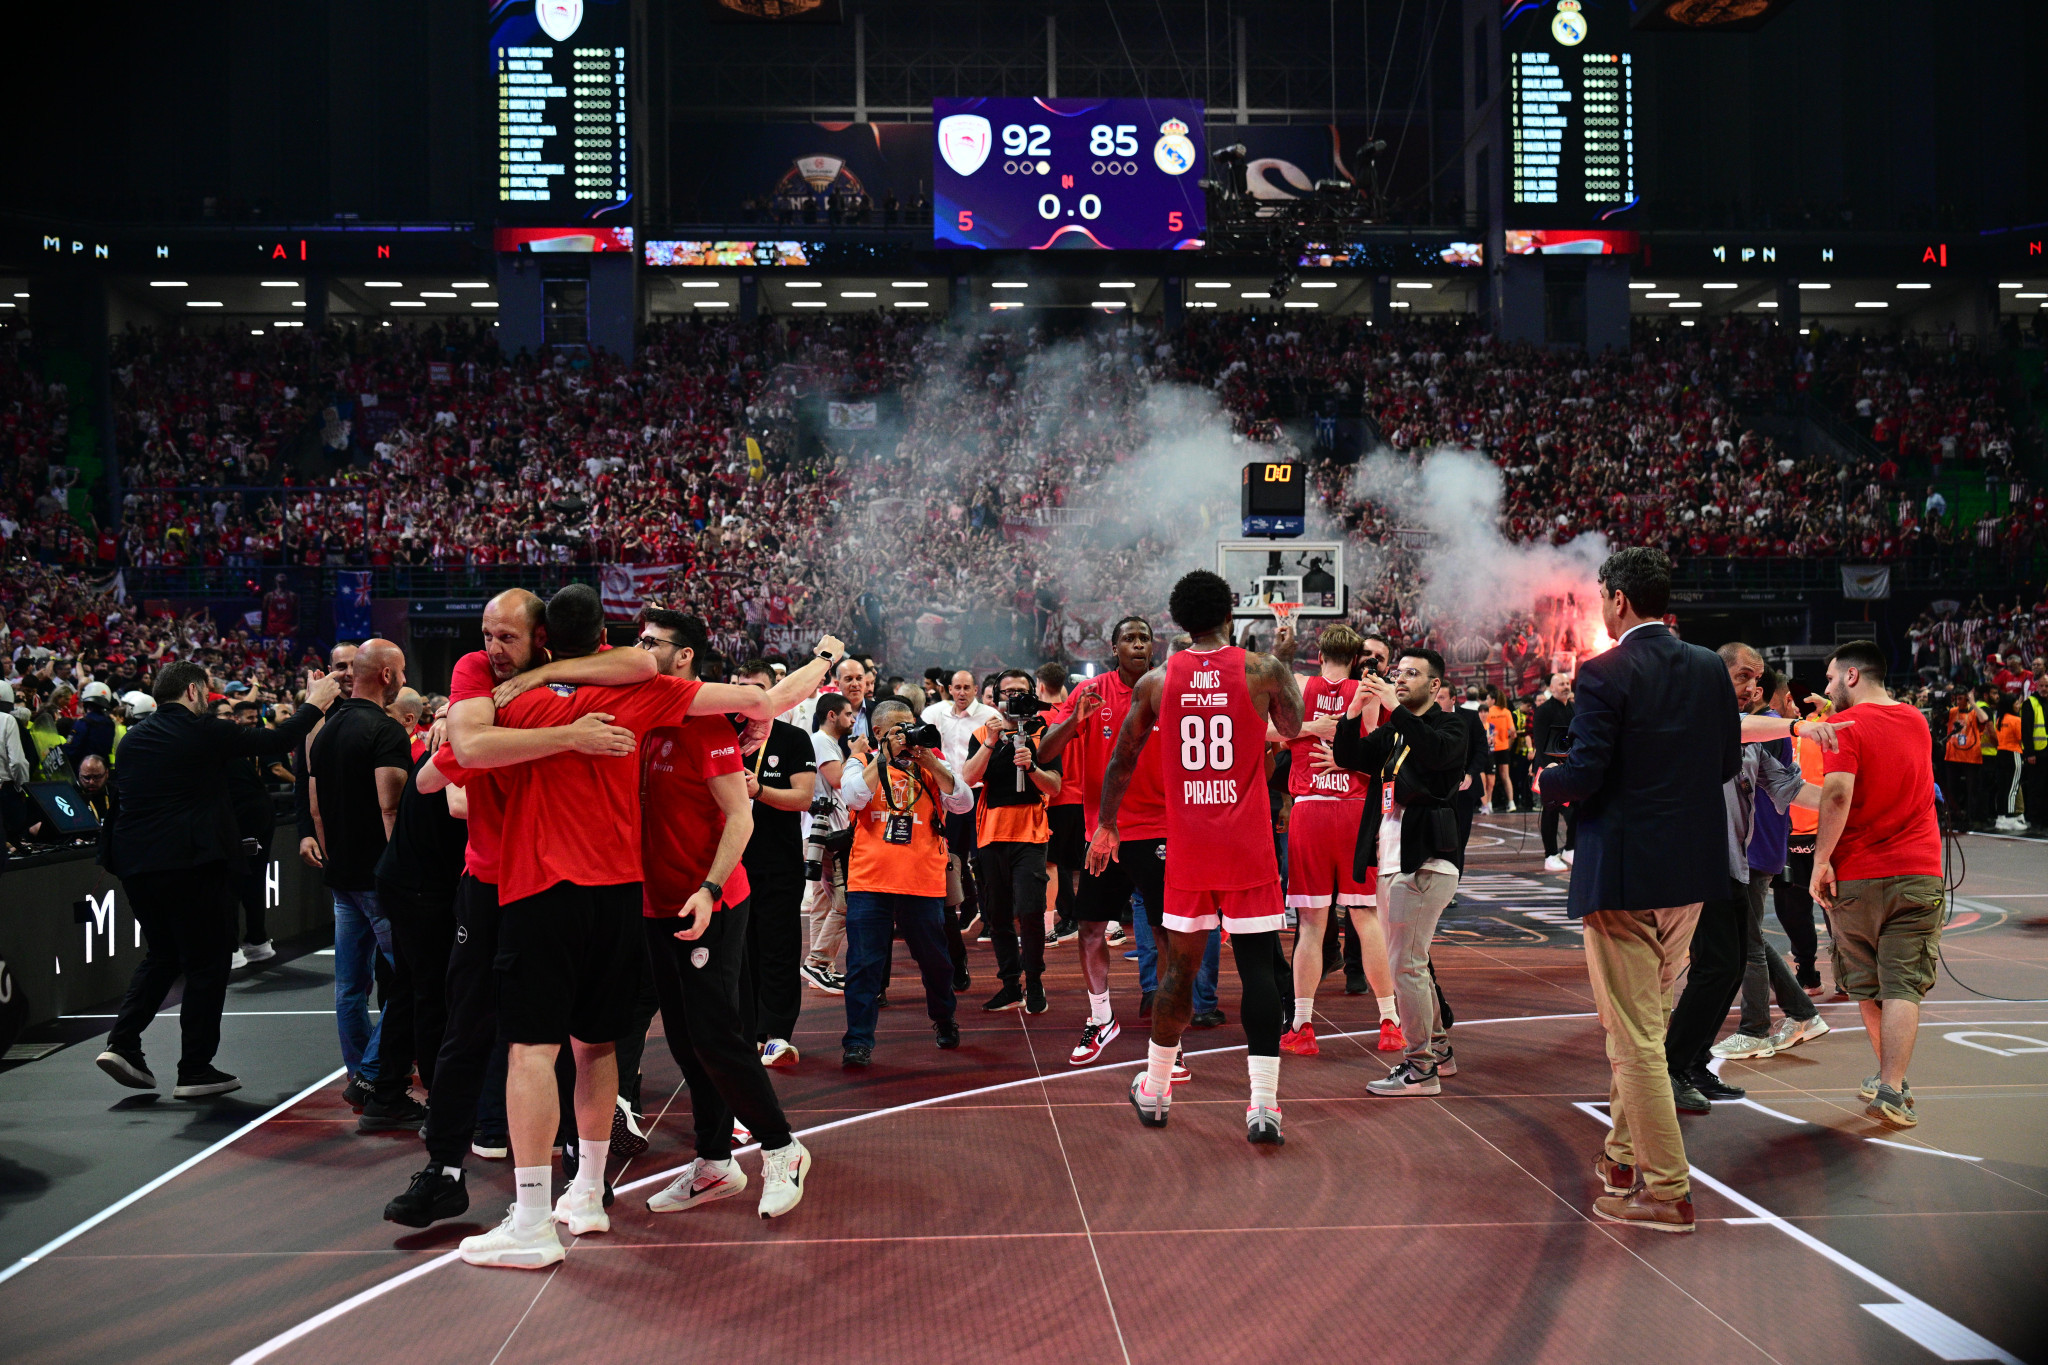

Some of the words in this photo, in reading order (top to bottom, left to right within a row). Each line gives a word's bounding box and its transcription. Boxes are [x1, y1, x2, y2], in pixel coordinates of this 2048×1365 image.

[1002, 124, 1051, 157] 92
[1089, 124, 1138, 157] 85
[1062, 175, 1073, 189] Q4
[958, 211, 973, 231] 5
[1168, 211, 1183, 232] 5
[157, 245, 169, 259] H
[378, 245, 390, 259] N
[1823, 248, 1834, 262] H
[1190, 670, 1220, 688] JONES
[1181, 693, 1227, 706] FMS
[1180, 714, 1234, 771] 88
[710, 746, 735, 758] FMS
[653, 762, 673, 772] bwin
[763, 770, 781, 778] bwin
[1184, 780, 1238, 805] PIRAEUS
[870, 811, 923, 824] FIL
